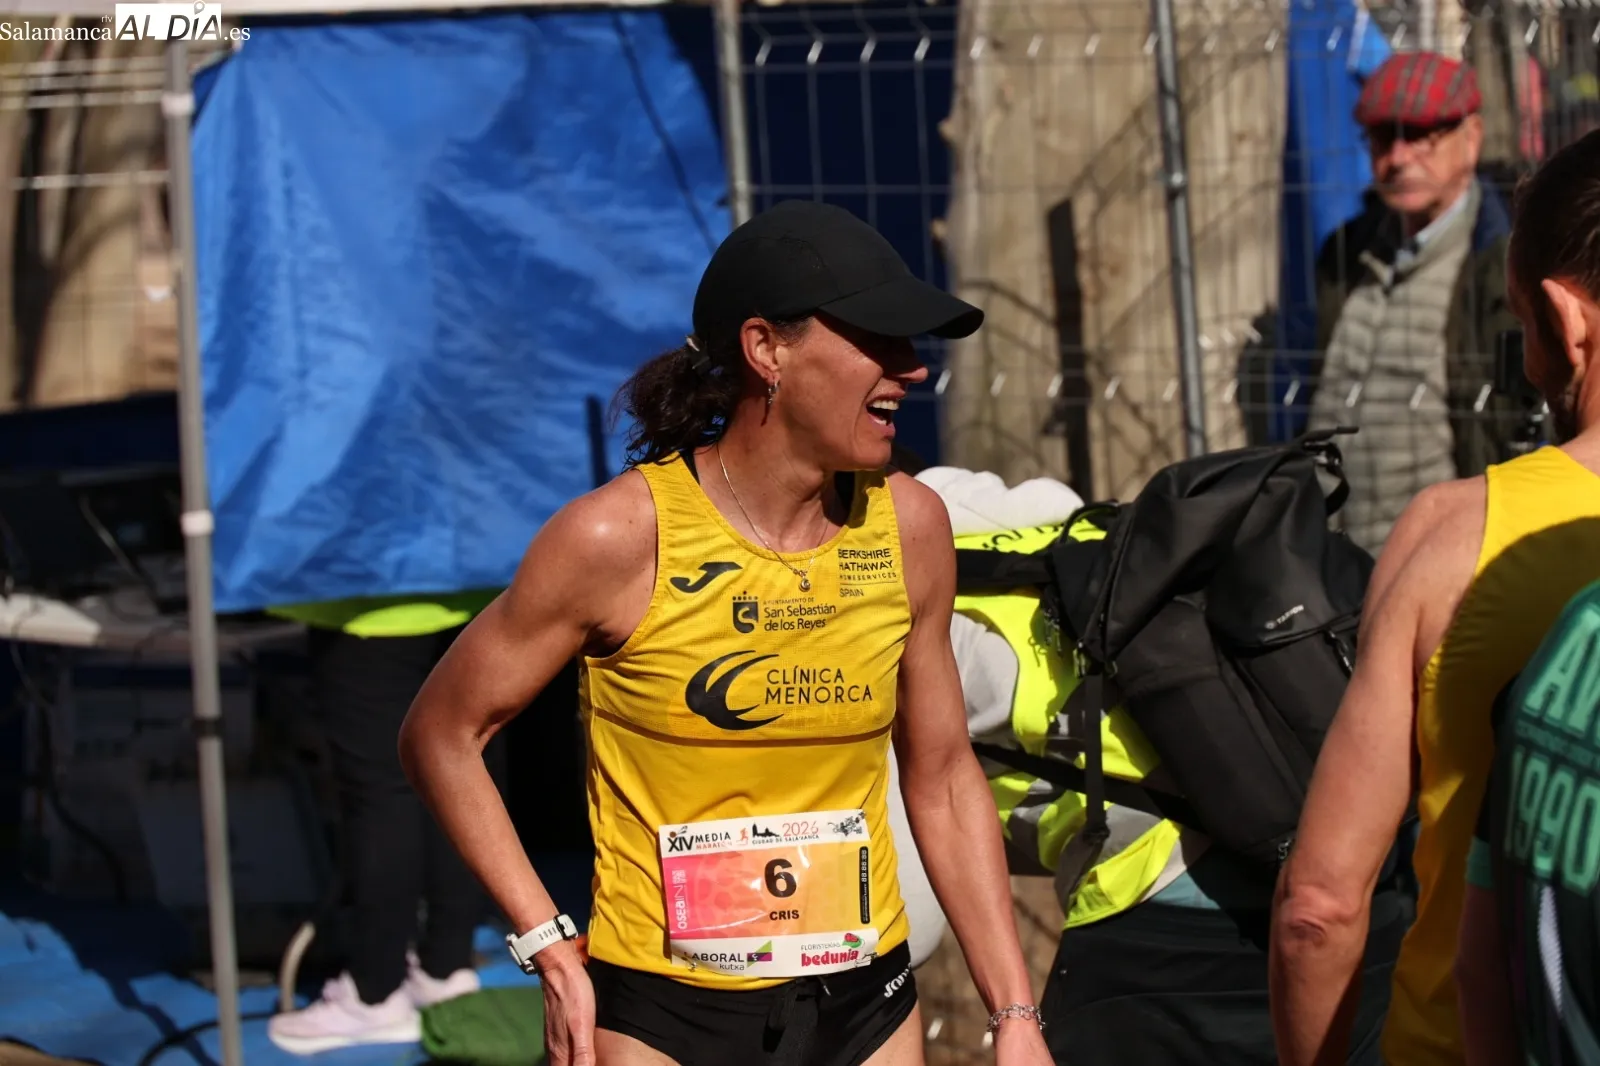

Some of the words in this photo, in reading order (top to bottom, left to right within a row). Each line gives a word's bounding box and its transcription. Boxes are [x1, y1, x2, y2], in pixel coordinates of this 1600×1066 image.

[838, 548, 891, 560] BERKSHIRE
[839, 560, 893, 571] HATHAWAY
[839, 588, 864, 597] SPAIN
[764, 607, 785, 618] San
[786, 603, 837, 617] Sebastián
[764, 619, 779, 631] de
[780, 619, 795, 631] los
[797, 618, 827, 631] Reyes
[767, 665, 845, 685] CLÍNICA
[765, 685, 873, 705] MENORCA
[782, 821, 820, 837] 2026
[1503, 745, 1600, 899] 1990
[667, 835, 694, 853] XIV
[695, 832, 732, 844] MEDIA
[764, 858, 797, 899] 6
[769, 910, 800, 922] CRIS
[684, 952, 745, 963] ABORAL
[801, 948, 859, 967] bedunia
[719, 963, 745, 971] kutxa
